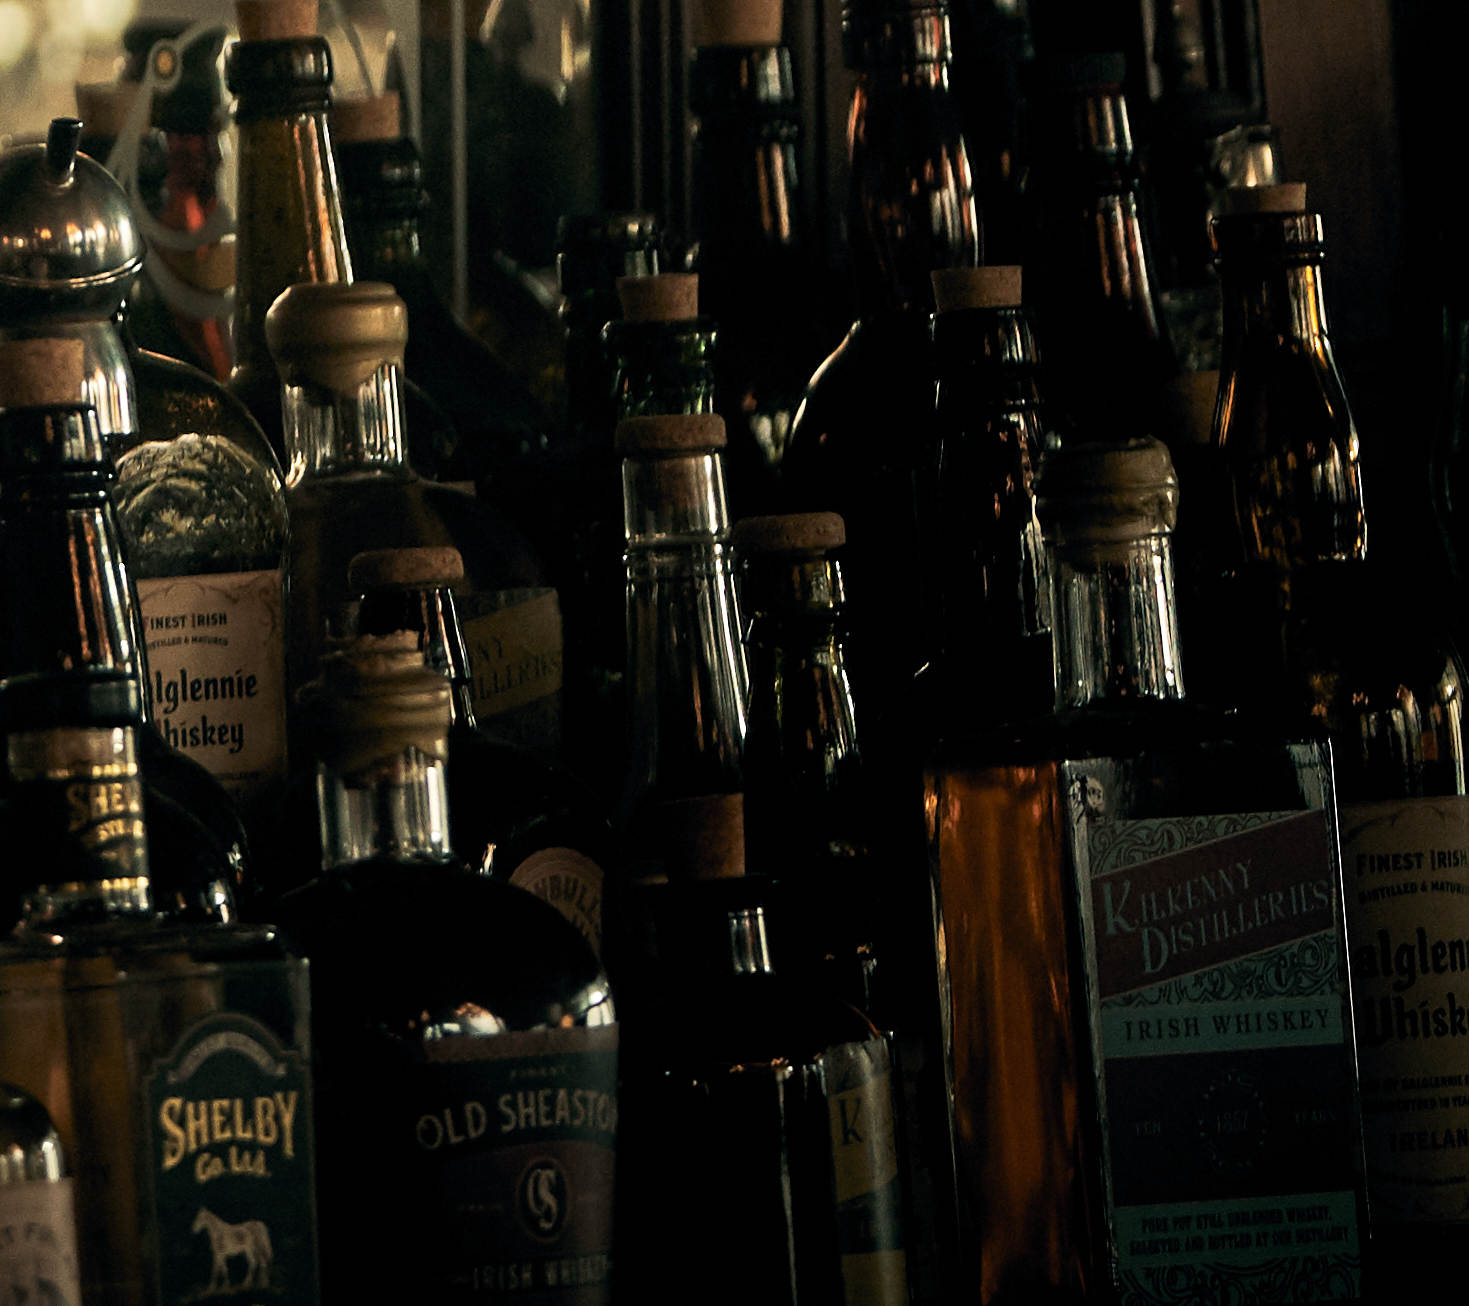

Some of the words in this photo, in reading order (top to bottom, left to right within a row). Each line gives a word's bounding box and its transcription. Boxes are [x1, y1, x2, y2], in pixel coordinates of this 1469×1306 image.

[192, 612, 227, 629] IRISH
[155, 667, 257, 714] lglennie
[160, 715, 244, 754] hiskey
[1356, 852, 1424, 877] FINEST
[1102, 858, 1252, 936] KILKENNY
[1141, 879, 1330, 975] DISTILLERIES
[1353, 926, 1469, 992] alglen
[1124, 1016, 1200, 1042] IRISH
[1212, 1008, 1330, 1035] WHISKEY
[1358, 992, 1469, 1047] Whisk
[158, 1090, 299, 1172] SHELBY
[415, 1100, 488, 1151] OLD
[1389, 1128, 1469, 1153] IRELAN
[472, 1263, 534, 1291] IRISH
